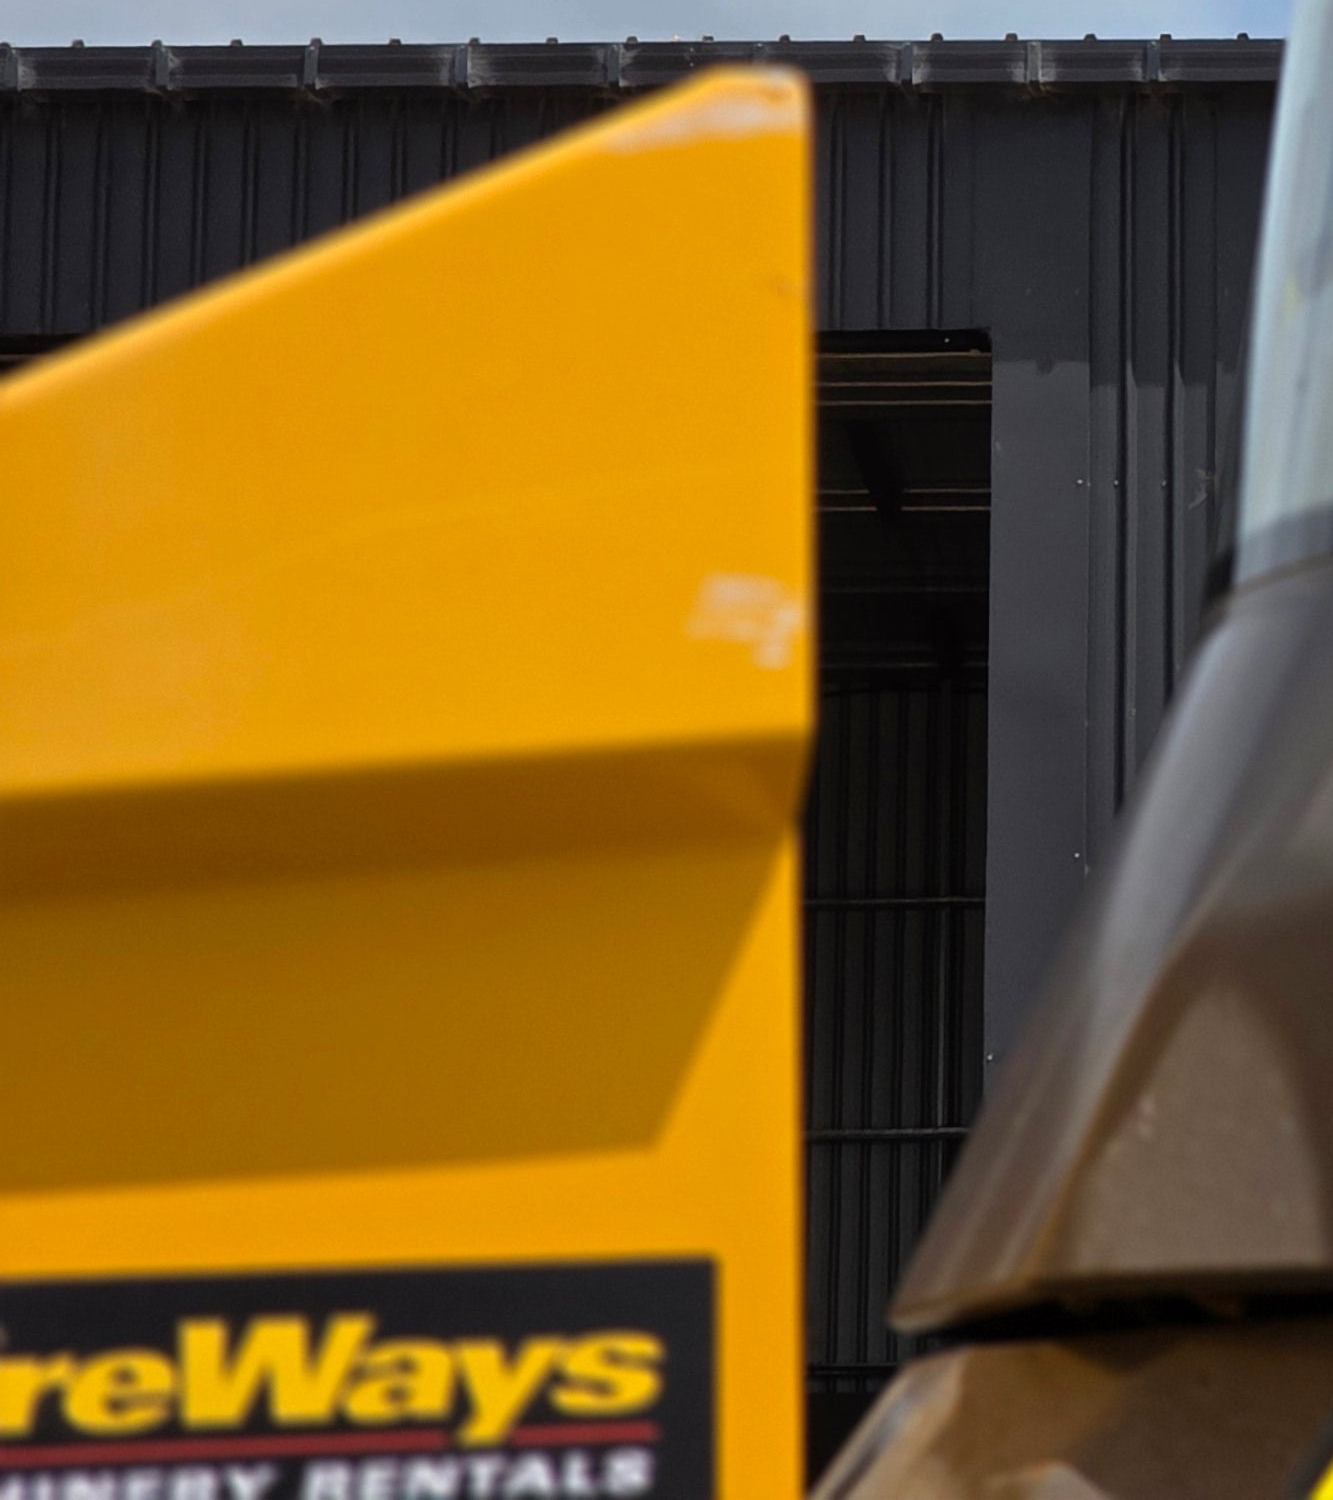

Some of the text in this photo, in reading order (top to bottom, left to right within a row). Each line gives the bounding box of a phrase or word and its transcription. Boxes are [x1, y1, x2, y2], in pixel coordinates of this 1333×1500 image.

[0, 1312, 665, 1444] reWays
[0, 1448, 654, 1500] INERY RENTALS
